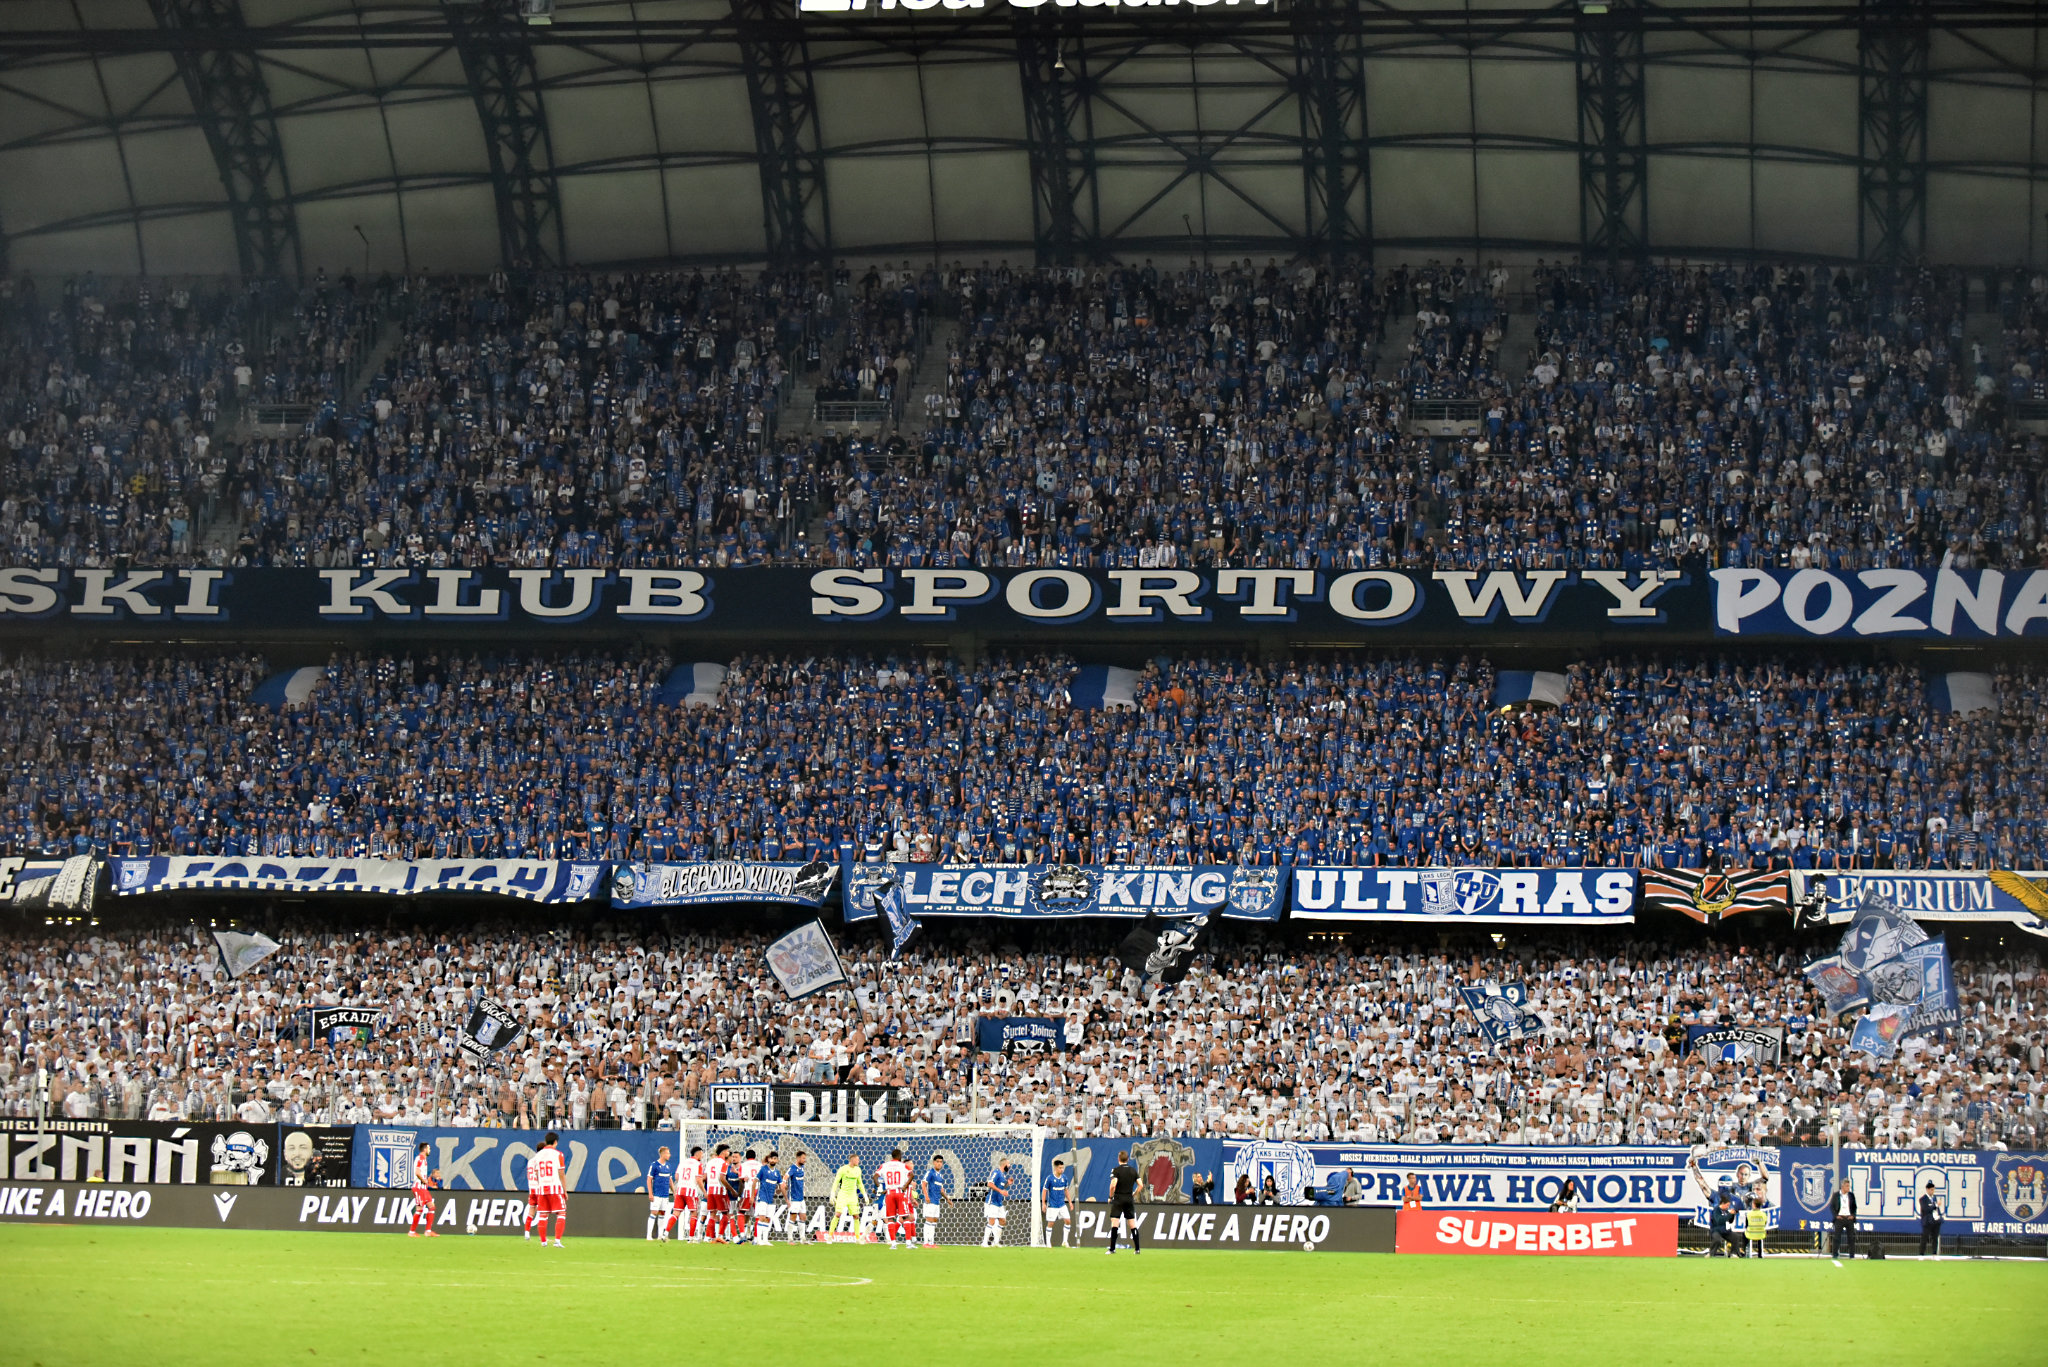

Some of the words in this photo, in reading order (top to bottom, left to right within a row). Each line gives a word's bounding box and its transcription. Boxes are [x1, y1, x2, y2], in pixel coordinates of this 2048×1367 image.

[319, 568, 706, 617] KLUB
[809, 568, 1681, 619] SPORTOWY
[748, 866, 794, 898] KLIKA
[903, 870, 1029, 906] LECH
[1098, 871, 1226, 906] KING
[1454, 877, 1497, 900] LPU
[1838, 877, 1996, 912] IMPERIUM
[986, 905, 1022, 914] TOBIE
[1694, 1030, 1778, 1048] RATAJSCY
[374, 1135, 389, 1143] KKS
[392, 1135, 411, 1144] LECH
[1259, 1150, 1272, 1159] KKS
[1274, 1150, 1291, 1159] LECH
[538, 1160, 553, 1178] 66
[1339, 1153, 1363, 1162] NOSISZ
[1422, 1154, 1447, 1164] BARWY
[1452, 1154, 1463, 1164] NA
[1464, 1154, 1480, 1165] NICH
[1613, 1156, 1634, 1166] TERAZ
[1647, 1156, 1655, 1165] TO
[1656, 1156, 1674, 1165] LECH
[1855, 1152, 1920, 1164] PYRLANDIA
[1924, 1152, 1977, 1165] FOREVER
[886, 1171, 901, 1186] 80
[1506, 1174, 1686, 1204] HONORU
[1847, 1165, 1984, 1220] LECH
[45, 1188, 65, 1217] A
[74, 1189, 152, 1219] HERO
[299, 1195, 370, 1223] PLAY
[437, 1198, 457, 1227] A
[1153, 1212, 1217, 1242] LIKE
[1219, 1212, 1240, 1241] A
[1250, 1213, 1330, 1243] HERO
[1435, 1215, 1638, 1251] SUPERBET
[1972, 1221, 1986, 1234] WE
[1987, 1222, 2005, 1235] ARE
[2006, 1222, 2023, 1235] THE
